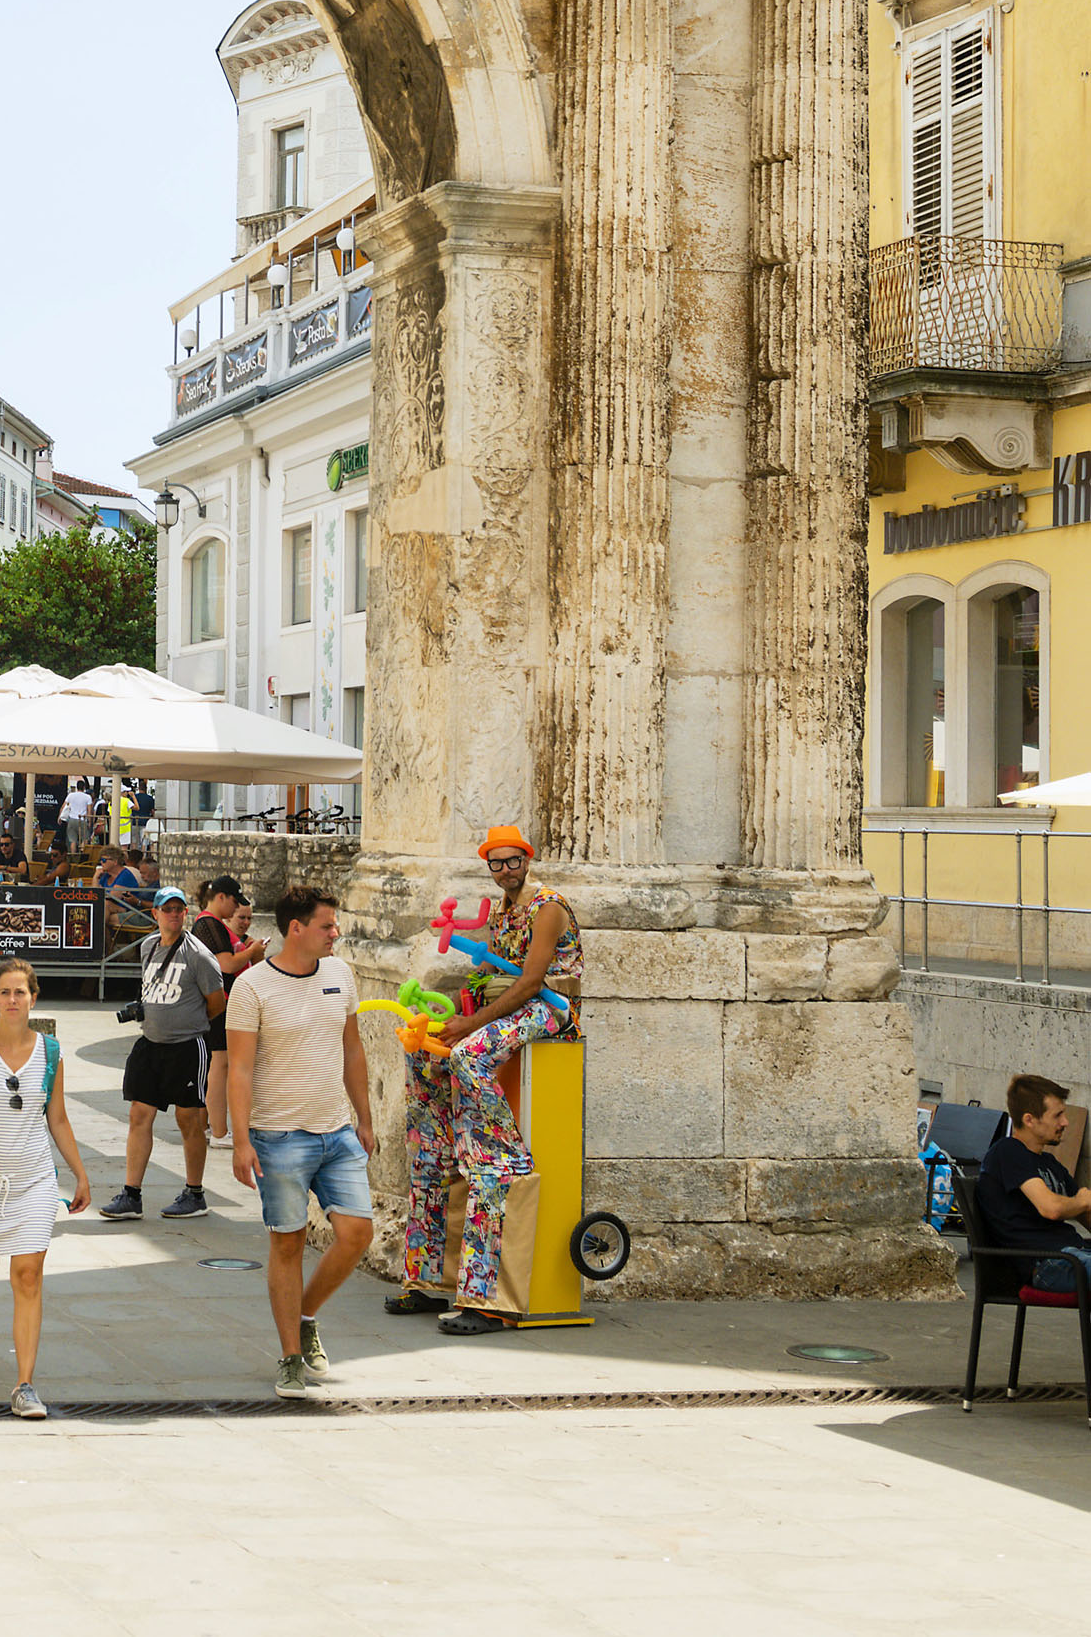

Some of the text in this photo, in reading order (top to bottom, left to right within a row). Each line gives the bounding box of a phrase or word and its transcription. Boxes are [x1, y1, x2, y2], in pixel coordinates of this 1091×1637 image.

[308, 320, 326, 345] Pasta
[235, 355, 257, 377] Steaks
[53, 889, 99, 901] Cocktails
